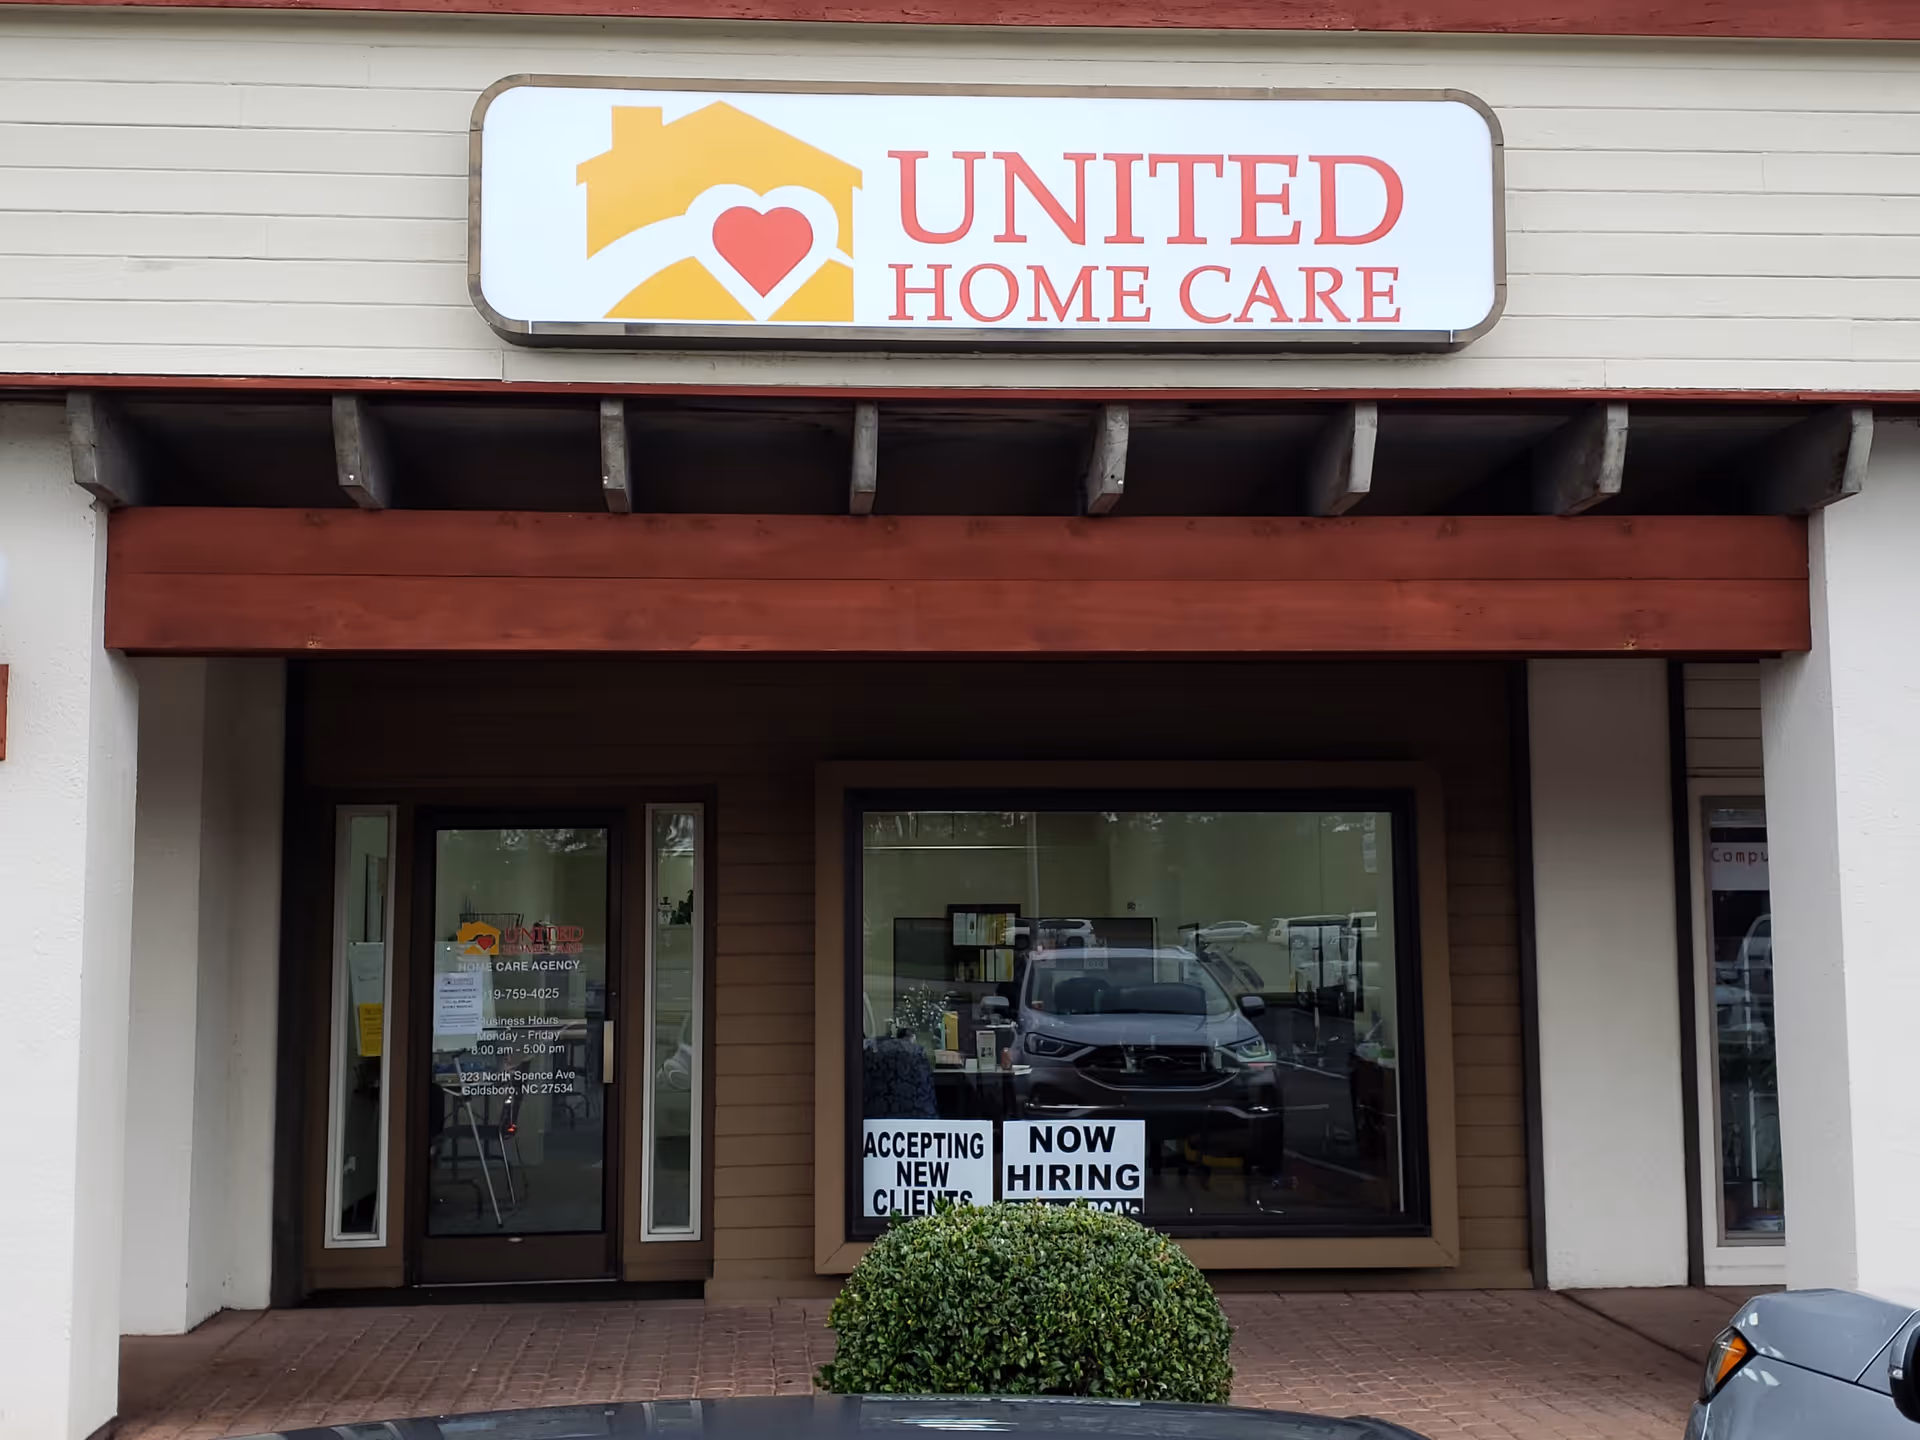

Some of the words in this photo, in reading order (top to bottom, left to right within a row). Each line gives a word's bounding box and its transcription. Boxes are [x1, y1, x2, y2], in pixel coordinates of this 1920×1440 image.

[888, 151, 1403, 245] UNITED
[889, 264, 1150, 322] HOME
[1179, 266, 1400, 323] CARE
[504, 925, 584, 943] UNITED
[458, 962, 493, 972] HOME
[495, 961, 529, 972] CARE
[531, 960, 581, 971] AGENCY
[528, 1015, 559, 1026] Hours
[477, 1031, 518, 1042] Monday
[528, 1030, 560, 1042] Friday
[471, 1045, 494, 1055] 8:00
[496, 1046, 513, 1055] am
[523, 1044, 546, 1054] 5:00
[549, 1045, 565, 1055] pm
[460, 1072, 480, 1082] 323
[482, 1071, 511, 1082] North
[514, 1071, 552, 1083] Spence
[555, 1070, 575, 1079] Ave
[521, 1084, 539, 1094] NC
[541, 1083, 573, 1094] 27534
[864, 1132, 984, 1159] ACCEPTING
[1029, 1126, 1116, 1153] NOW
[897, 1161, 949, 1188] NEW
[1007, 1164, 1140, 1192] HIRING
[873, 1189, 973, 1215] CLIENTS
